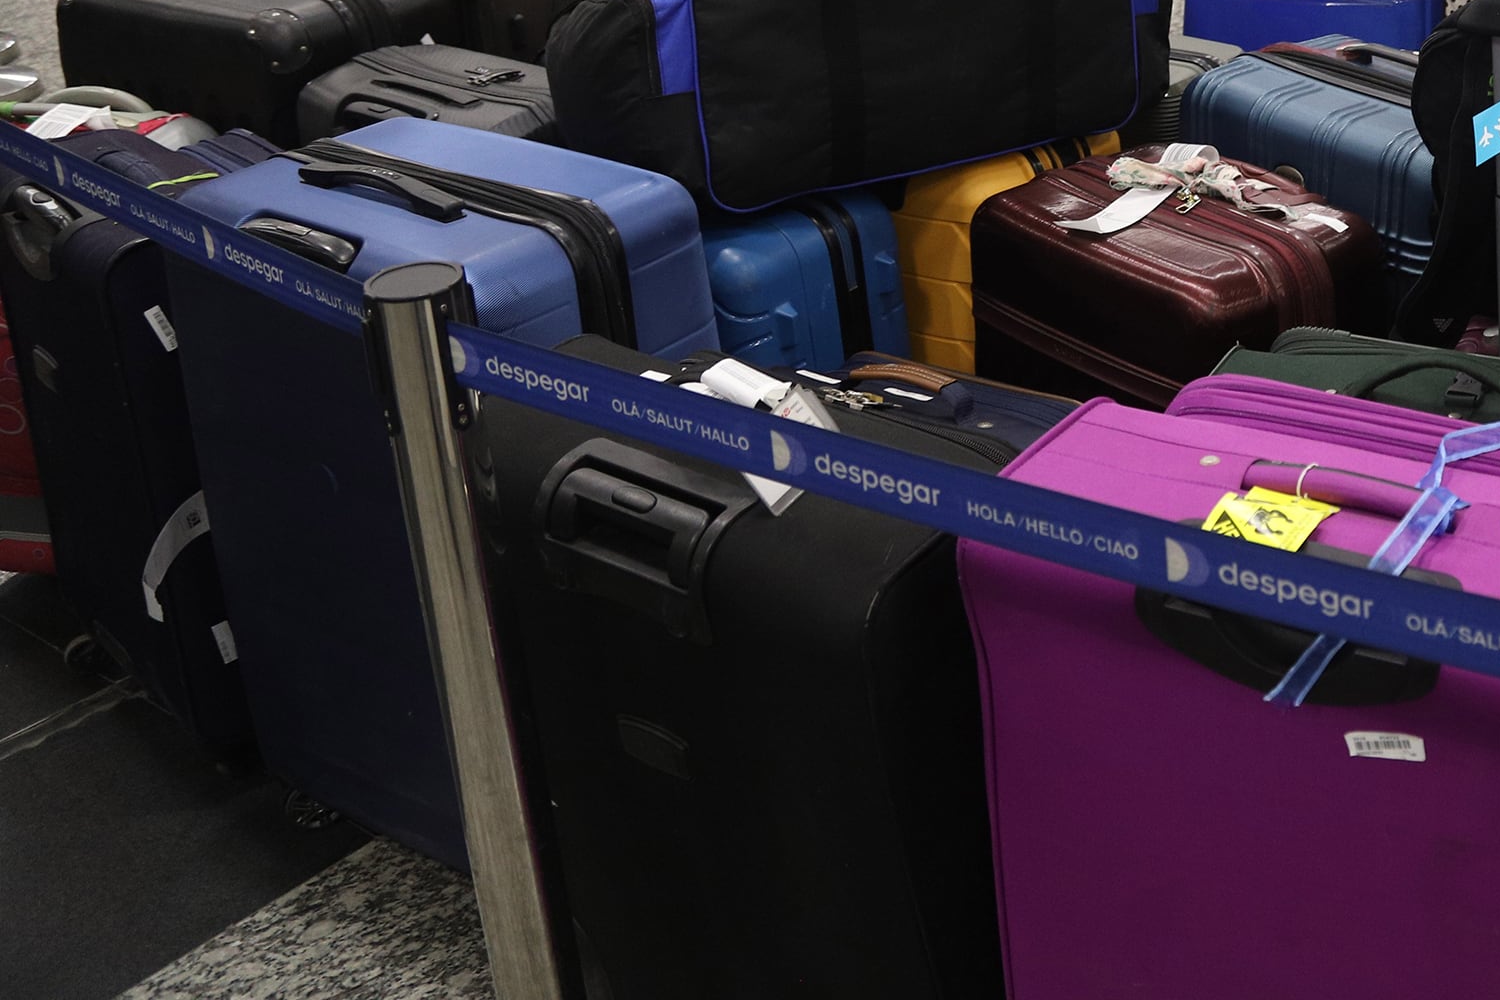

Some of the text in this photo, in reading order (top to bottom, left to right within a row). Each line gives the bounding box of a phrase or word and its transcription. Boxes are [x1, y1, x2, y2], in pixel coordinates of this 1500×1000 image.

[72, 172, 121, 207] despegar
[224, 244, 284, 284] despegar
[485, 354, 590, 404] despegar
[814, 453, 941, 507] despegar
[1218, 562, 1374, 622] despegar
